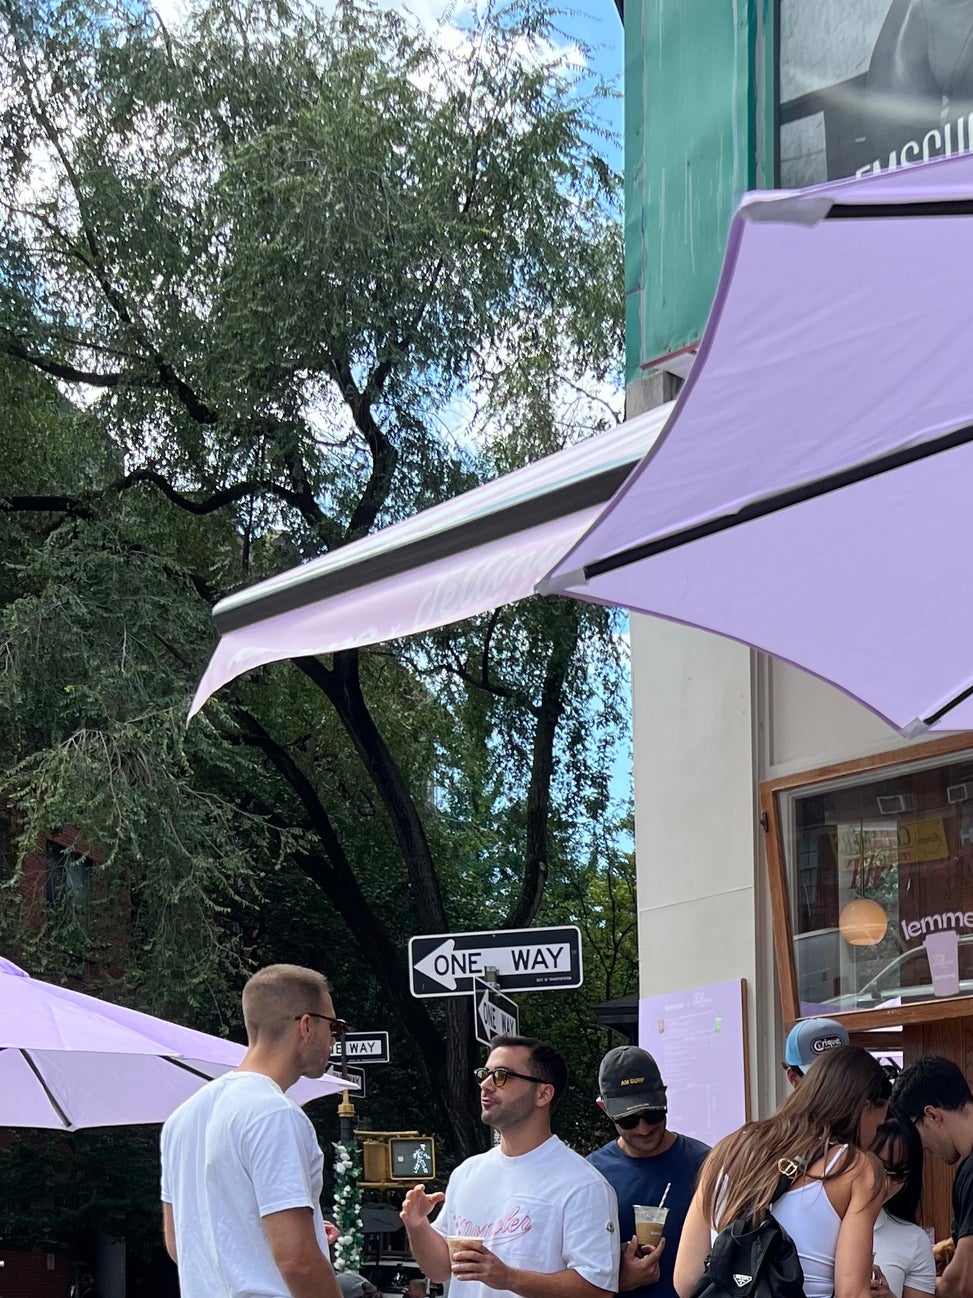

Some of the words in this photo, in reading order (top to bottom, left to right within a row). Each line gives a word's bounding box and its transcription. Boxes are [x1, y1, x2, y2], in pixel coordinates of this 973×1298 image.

[434, 953, 482, 976] ONE
[511, 947, 564, 971] WAY
[483, 1002, 495, 1029] ONE
[501, 1012, 515, 1036] WAY
[349, 1042, 375, 1053] WAY
